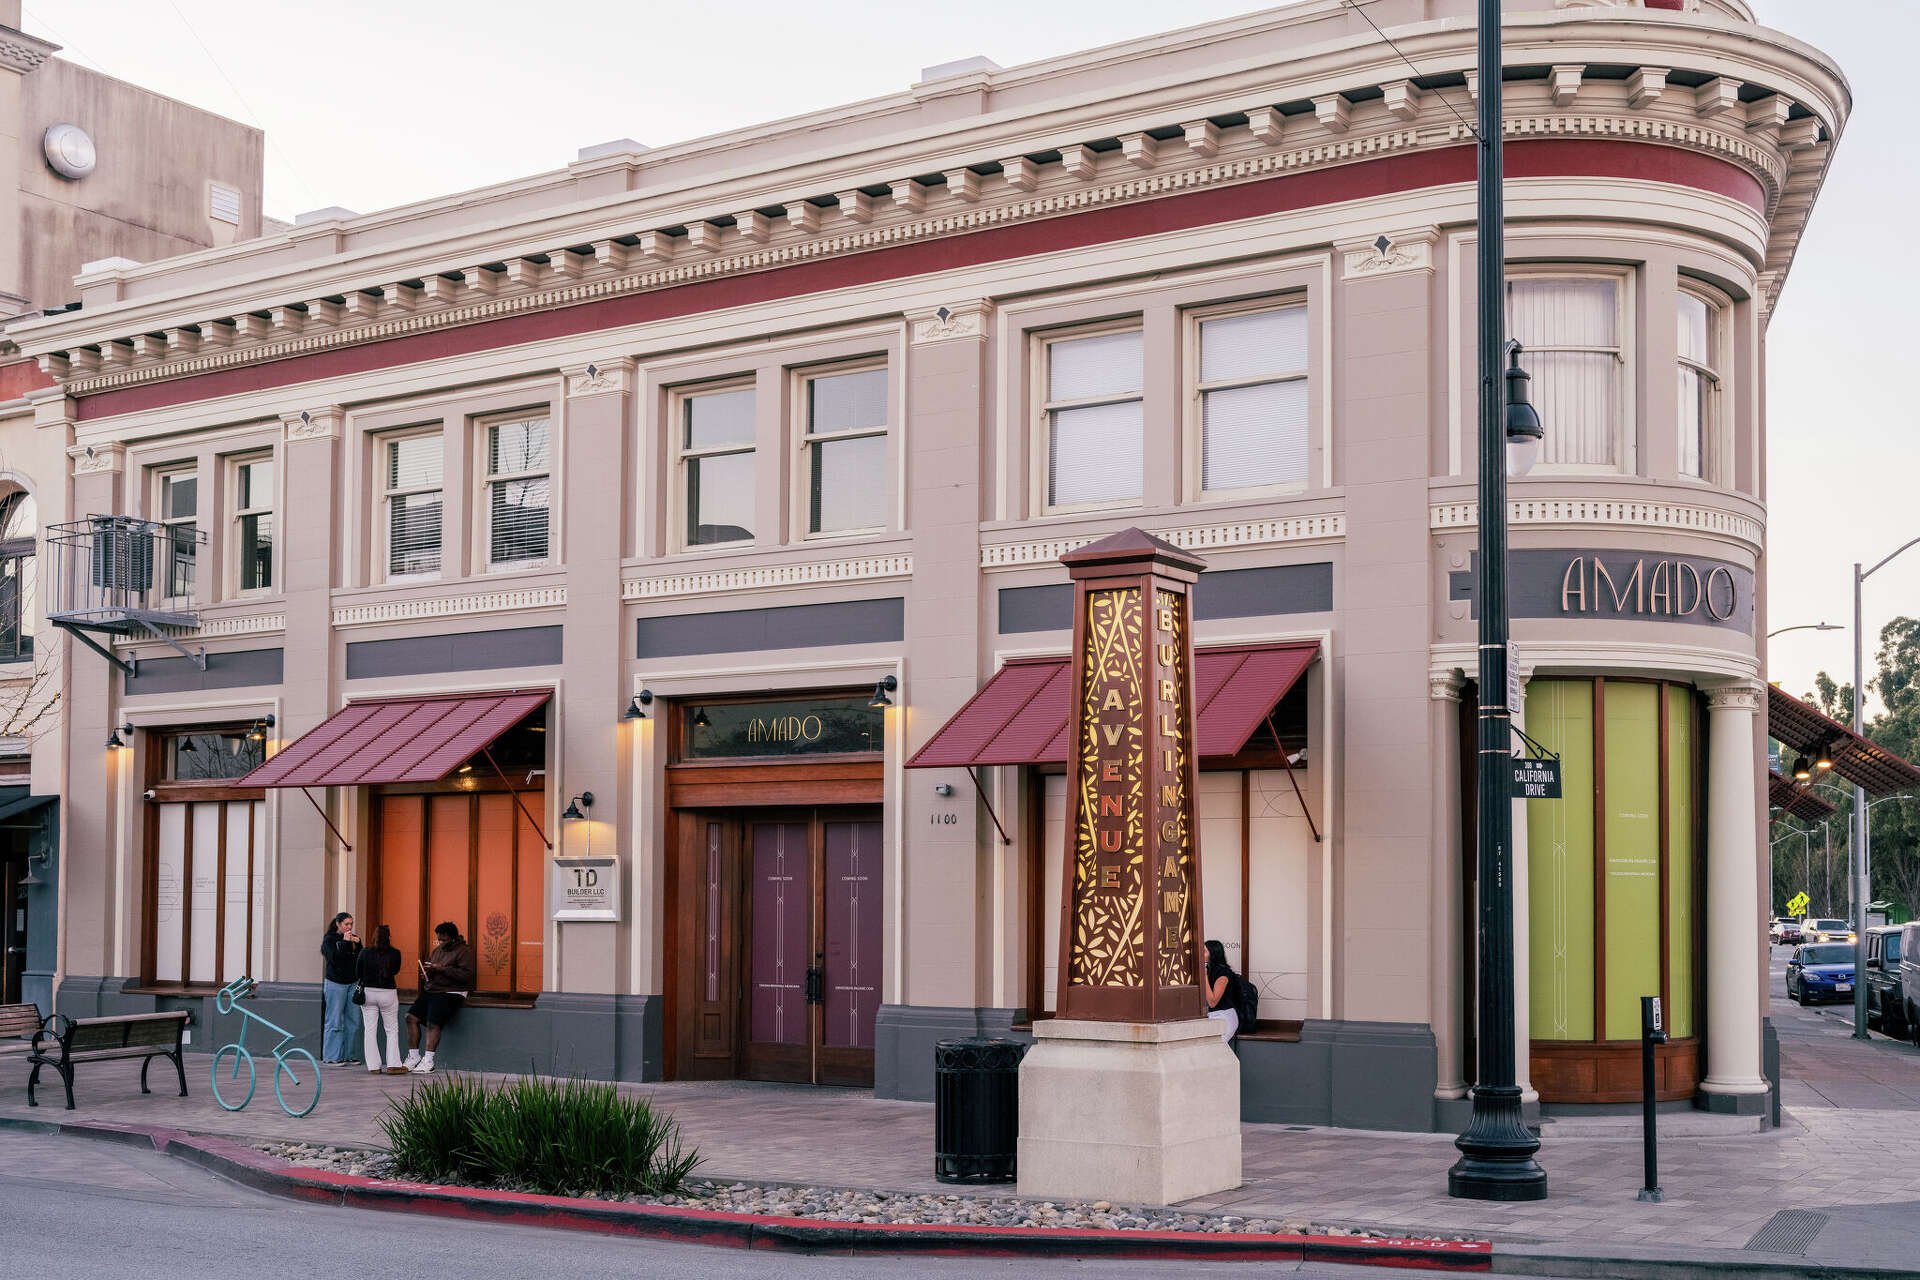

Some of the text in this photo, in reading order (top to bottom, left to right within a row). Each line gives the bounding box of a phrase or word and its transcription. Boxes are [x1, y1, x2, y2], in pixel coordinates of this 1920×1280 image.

[1562, 556, 1737, 622] AMADO
[748, 715, 822, 742] AMADO
[1157, 608, 1181, 950] BURLINGAME
[1514, 769, 1555, 783] CALIFORNIA
[1100, 688, 1125, 888] AVENUE
[1525, 783, 1546, 796] DRIVE
[930, 814, 957, 825] 1100
[574, 868, 598, 888] TD
[567, 888, 605, 896] BUILDER LLC
